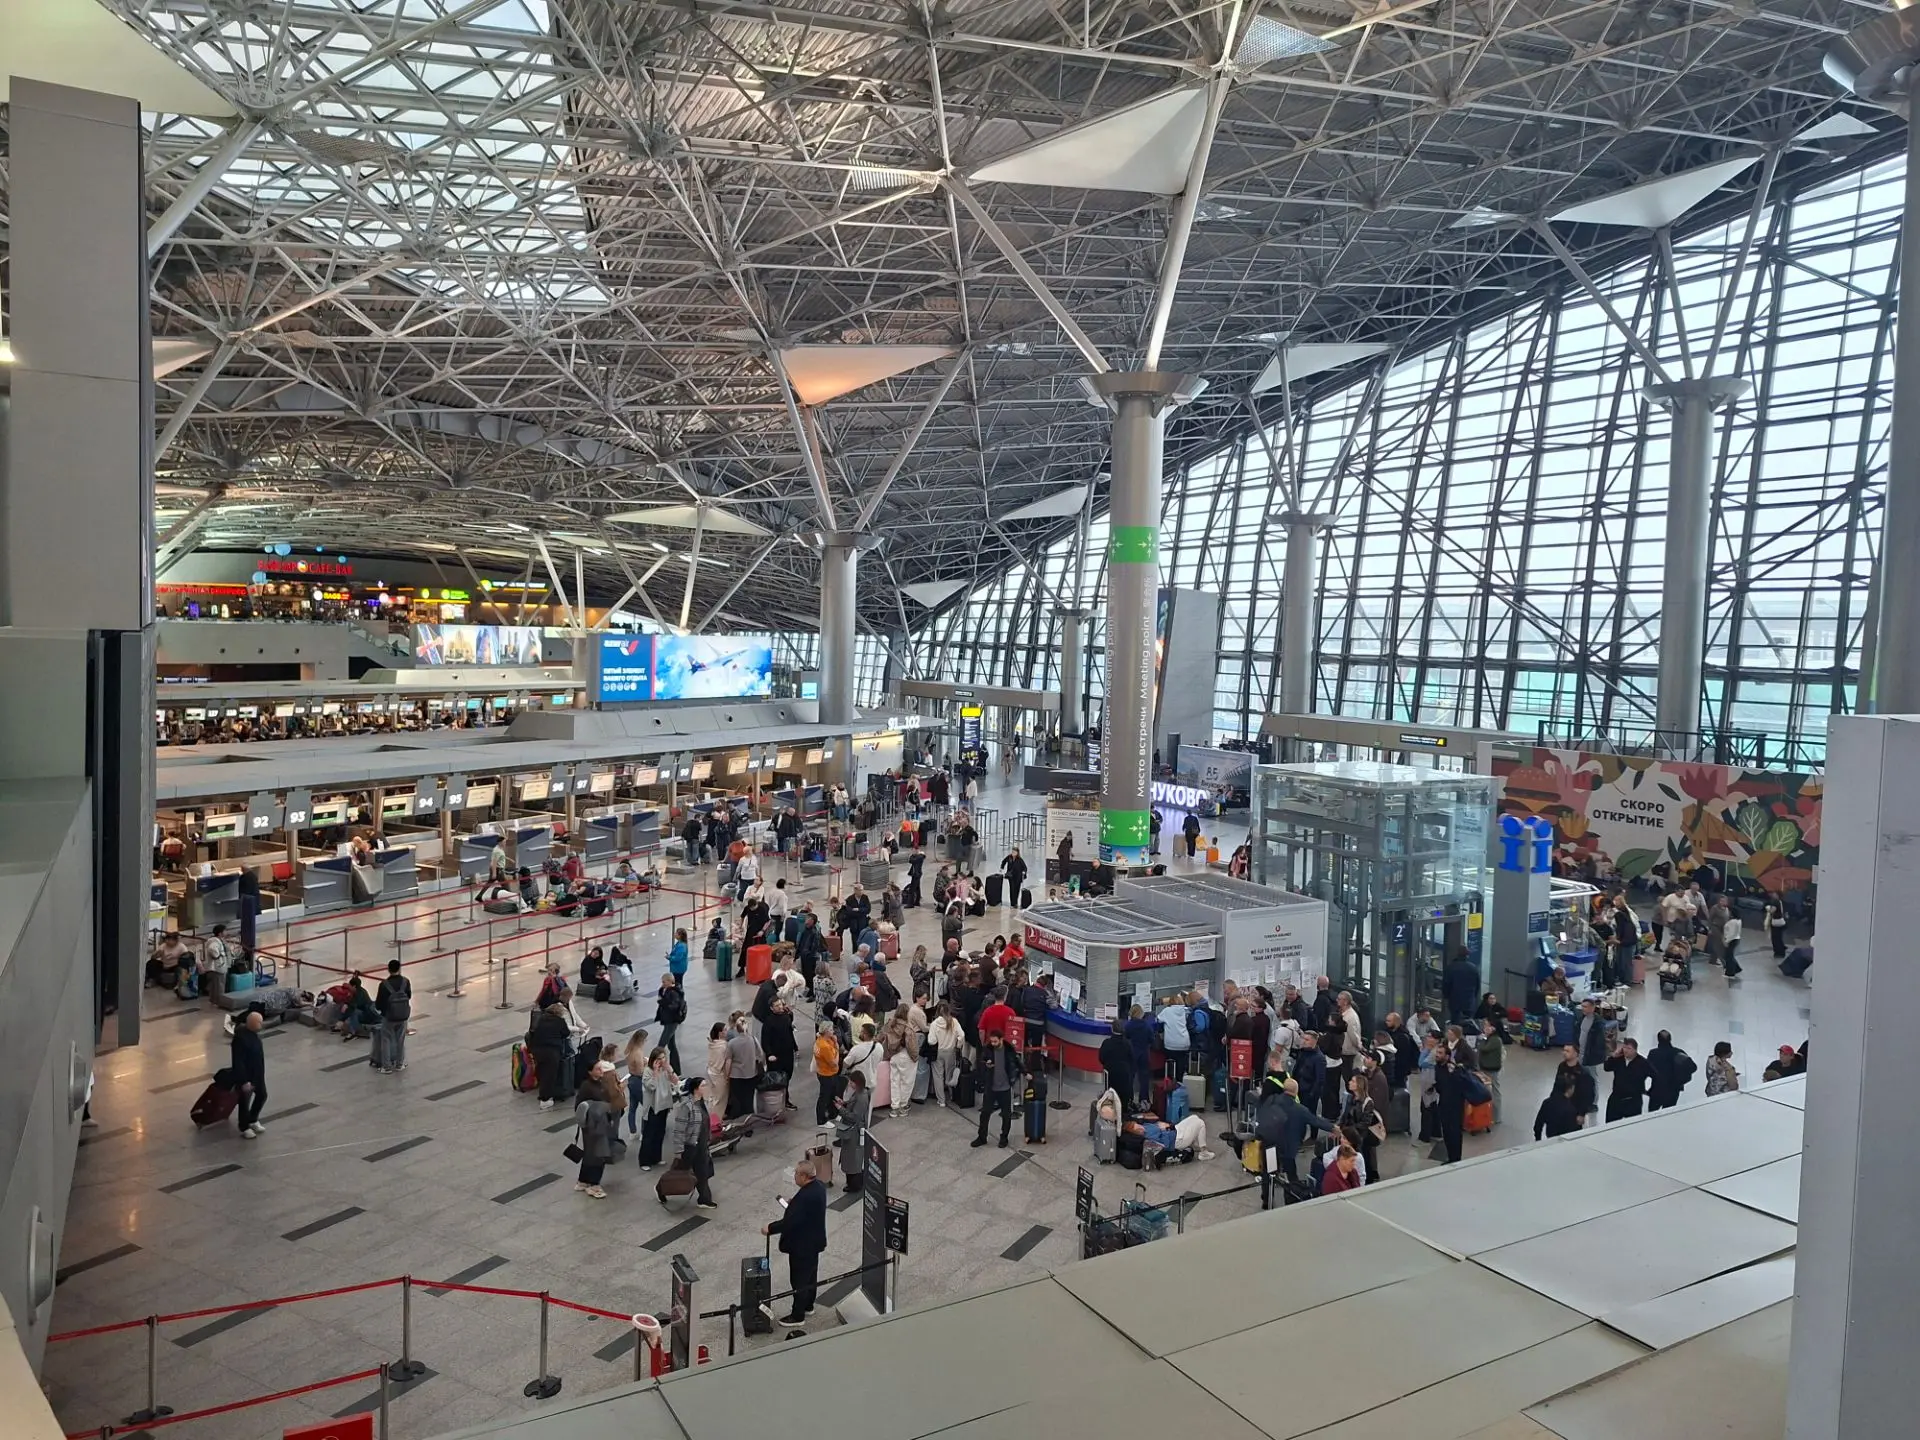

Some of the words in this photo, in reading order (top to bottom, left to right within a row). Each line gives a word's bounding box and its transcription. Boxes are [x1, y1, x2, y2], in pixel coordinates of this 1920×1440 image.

[1141, 616, 1150, 646] point
[1106, 650, 1115, 698] Meeting
[1140, 651, 1150, 698] Meeting
[1139, 706, 1147, 756] встречи
[1102, 758, 1110, 795] Место
[1137, 759, 1146, 797] Место
[576, 779, 588, 790] 97
[418, 797, 433, 808] 94
[449, 794, 463, 805] 95
[1620, 799, 1664, 813] СКОРО
[253, 815, 269, 828] 92
[290, 811, 306, 823] 93
[1592, 809, 1664, 828] ОТКРЫТИЕ
[1039, 930, 1062, 944] TURKISH
[1038, 938, 1062, 952] AIRLINES
[1144, 943, 1177, 954] TURKISH
[1143, 951, 1178, 962] AIRLINES
